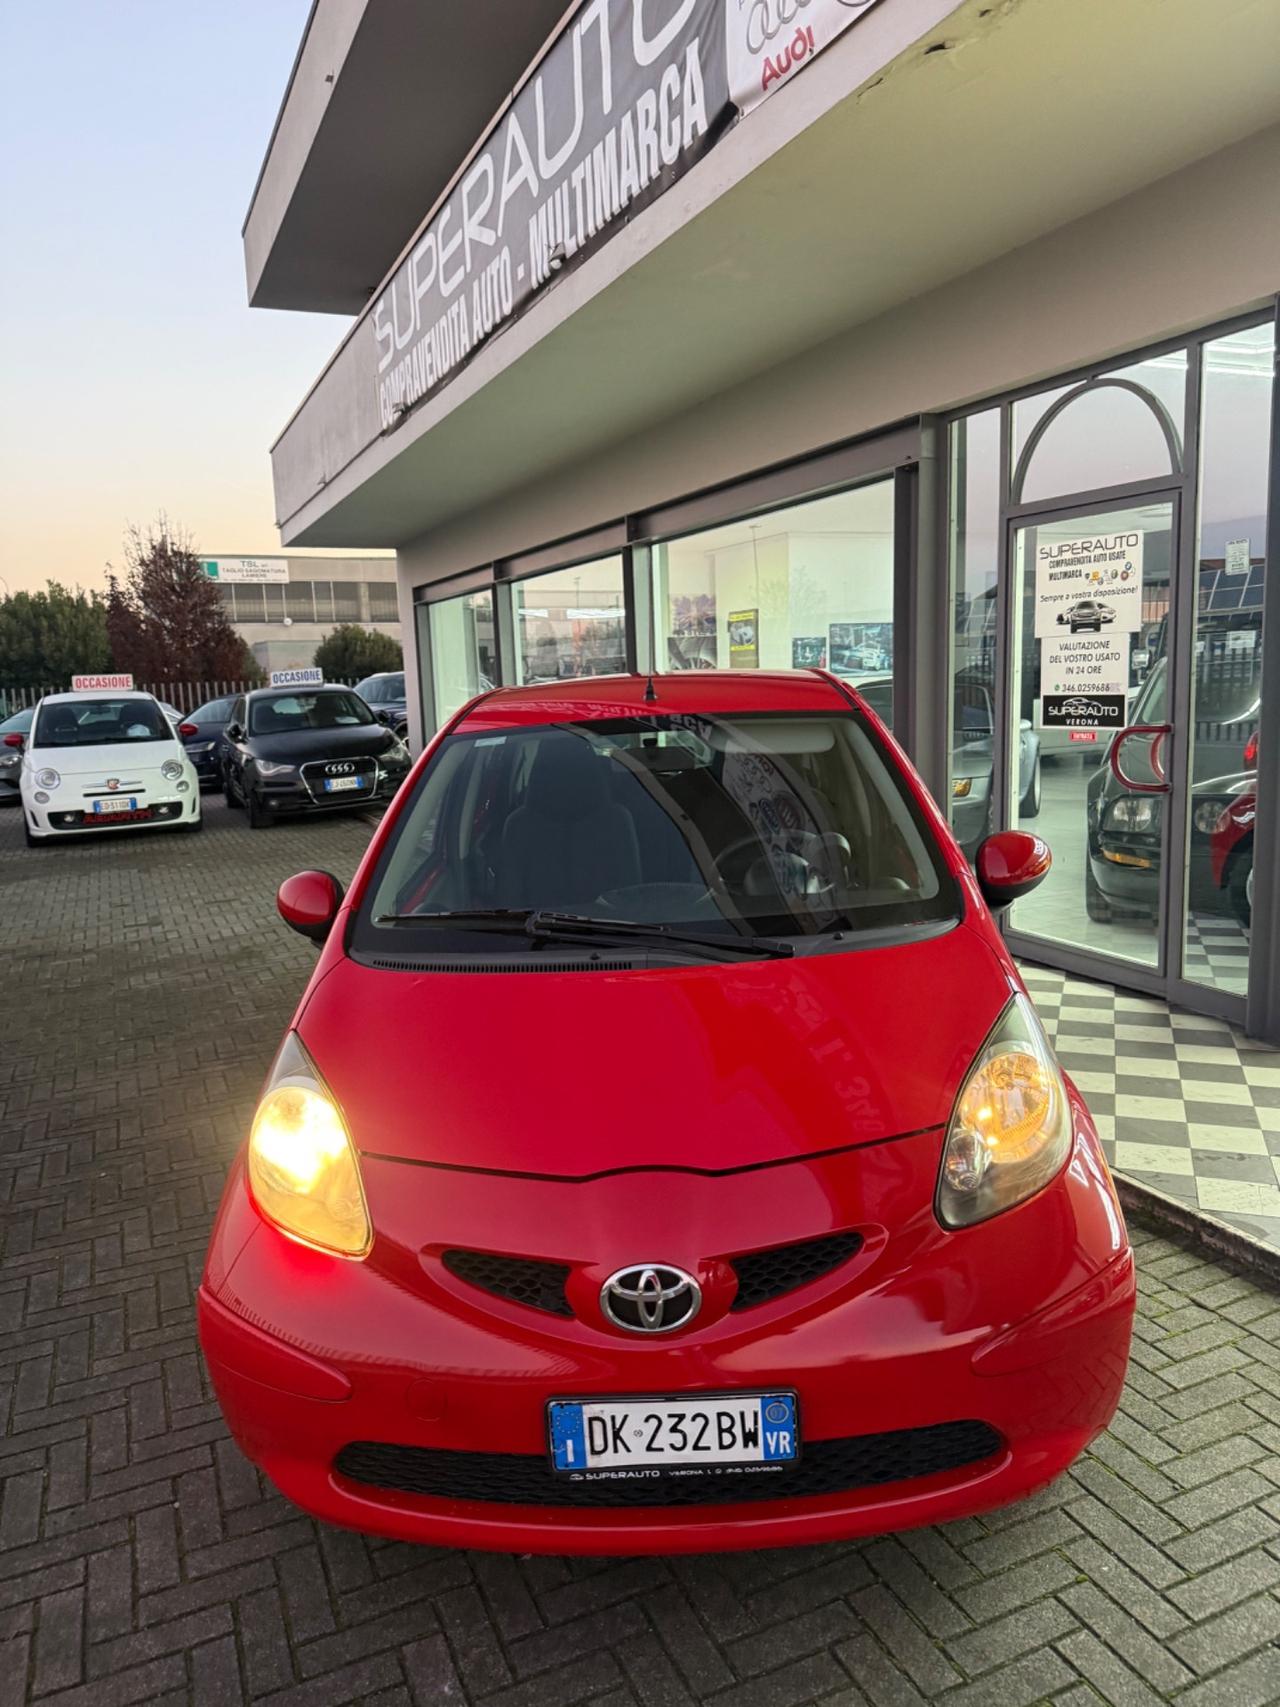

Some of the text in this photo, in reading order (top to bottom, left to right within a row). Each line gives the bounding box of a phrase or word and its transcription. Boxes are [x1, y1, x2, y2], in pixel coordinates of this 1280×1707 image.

[761, 25, 815, 91] Audi
[380, 294, 470, 429] COMPRAVENDITA
[473, 245, 513, 345] AUTO
[529, 37, 708, 289] MULTIMARCA
[1040, 534, 1138, 559] SUPERAUTO
[1048, 551, 1126, 568] COMPRAVENDITA AUTO USATE
[1048, 569, 1082, 581] MULTIMARCA
[1040, 594, 1064, 603] Sempre
[1071, 590, 1092, 599] vostra
[1093, 585, 1139, 598] disposizione!
[1059, 641, 1110, 651] VALUTAZIONE
[1049, 652, 1120, 663] DEL VOSTRO USATO
[273, 670, 321, 684] OCCASIONE
[1076, 666, 1085, 674] 24
[1087, 666, 1102, 674] ORE
[75, 676, 131, 689] OCCASIONE
[1048, 705, 1118, 716] SUPERAUTO
[588, 1410, 759, 1456] DK 232BW
[766, 1431, 791, 1454] VR
[586, 1469, 660, 1480] SUPERAUTO
